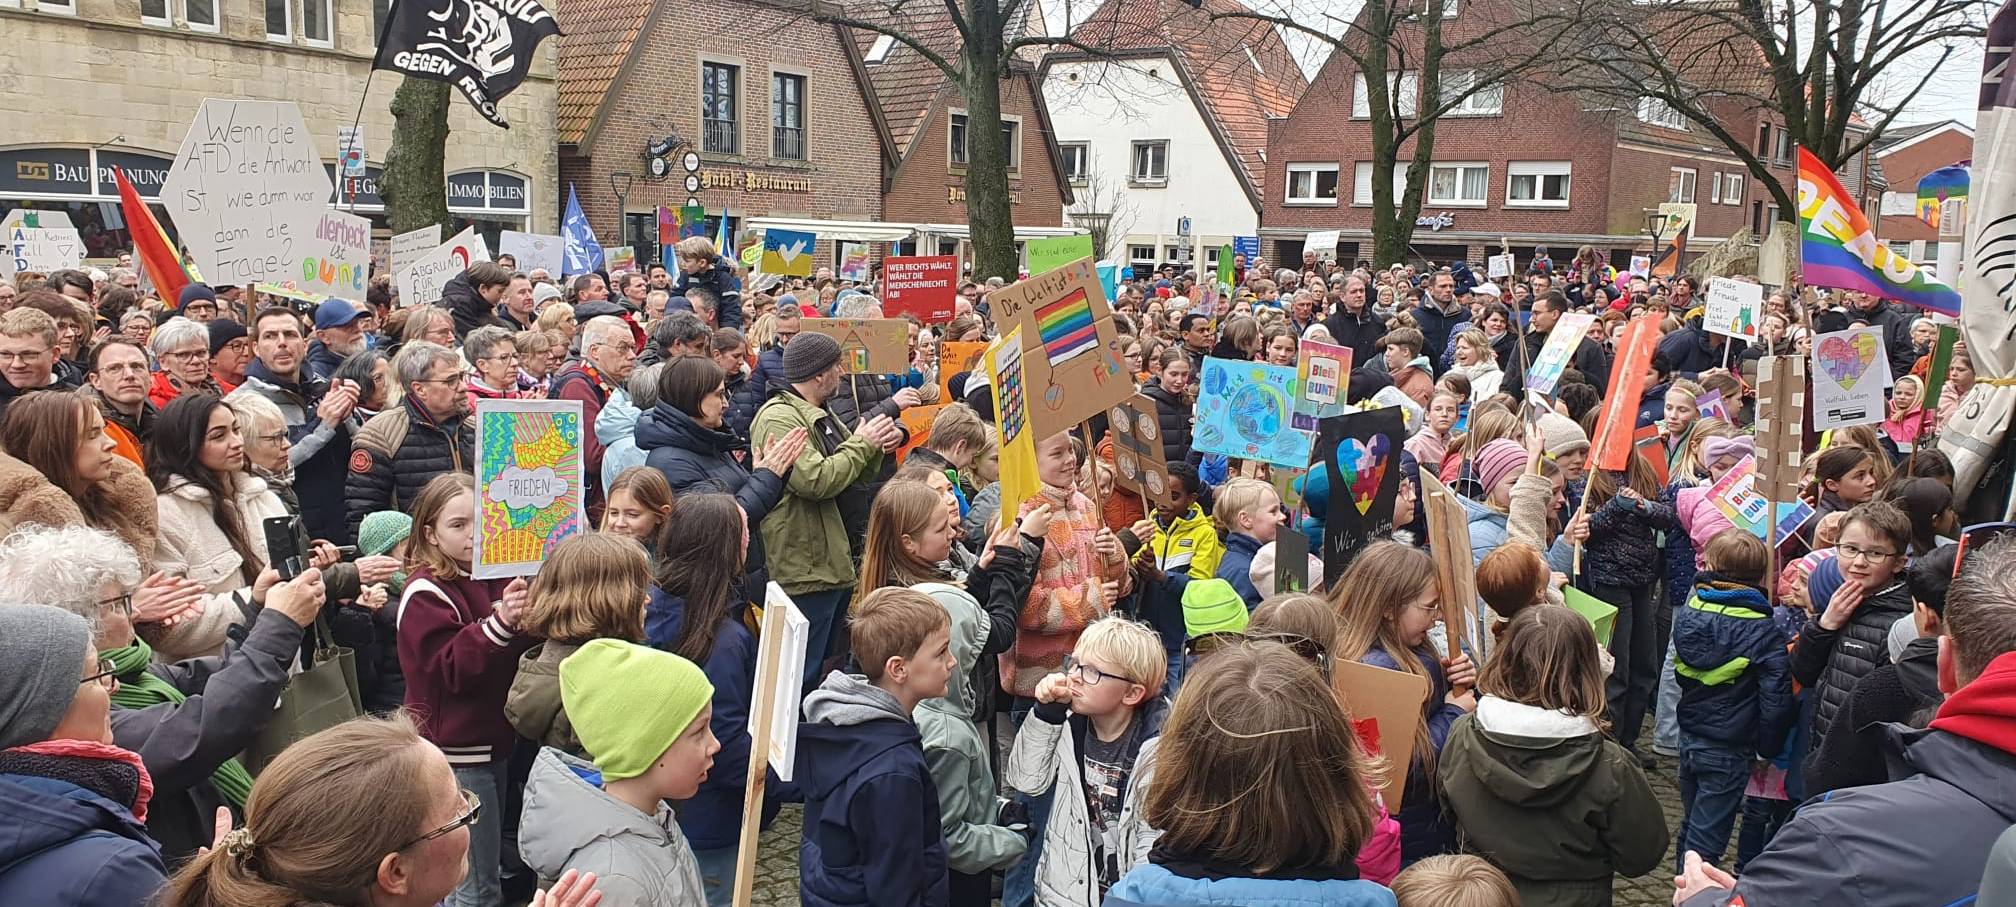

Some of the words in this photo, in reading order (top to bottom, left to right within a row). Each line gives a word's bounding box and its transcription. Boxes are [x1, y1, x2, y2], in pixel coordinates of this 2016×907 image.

[394, 51, 457, 77] GEGEN
[205, 103, 264, 144] Wenn
[267, 106, 295, 144] die
[184, 142, 232, 174] AFD
[238, 150, 259, 174] die
[264, 146, 312, 173] Antwort
[449, 182, 524, 200] IMMOBILIEN
[702, 170, 735, 189] Hotel
[745, 172, 812, 192] Restaurant
[226, 189, 254, 208] wie
[258, 179, 289, 206] dumm
[214, 212, 250, 243] dann
[265, 209, 289, 239] die
[1415, 211, 1455, 232] café
[215, 238, 293, 283] Frage?
[330, 241, 346, 260] ist
[410, 256, 461, 280] ABGRUND
[889, 263, 904, 271] WER
[905, 263, 929, 271] RECHTS
[930, 261, 953, 271] WÄHLT,
[889, 271, 911, 280] WÄHLT
[912, 271, 923, 280] DIE
[413, 287, 443, 304] DEUTS
[889, 280, 948, 289] MENSCHENRECHTE
[1001, 298, 1022, 317] Die
[1022, 282, 1053, 305] Welt
[1053, 272, 1067, 292] ist
[1312, 364, 1335, 379] Bleib
[1221, 373, 1244, 401] Welt
[1268, 371, 1283, 383] ist
[1308, 382, 1335, 398] BUNT!
[508, 478, 551, 497] FRIEDEN
[1731, 483, 1754, 506] Blei
[1743, 498, 1767, 519] BUN
[1334, 529, 1356, 553] Wir
